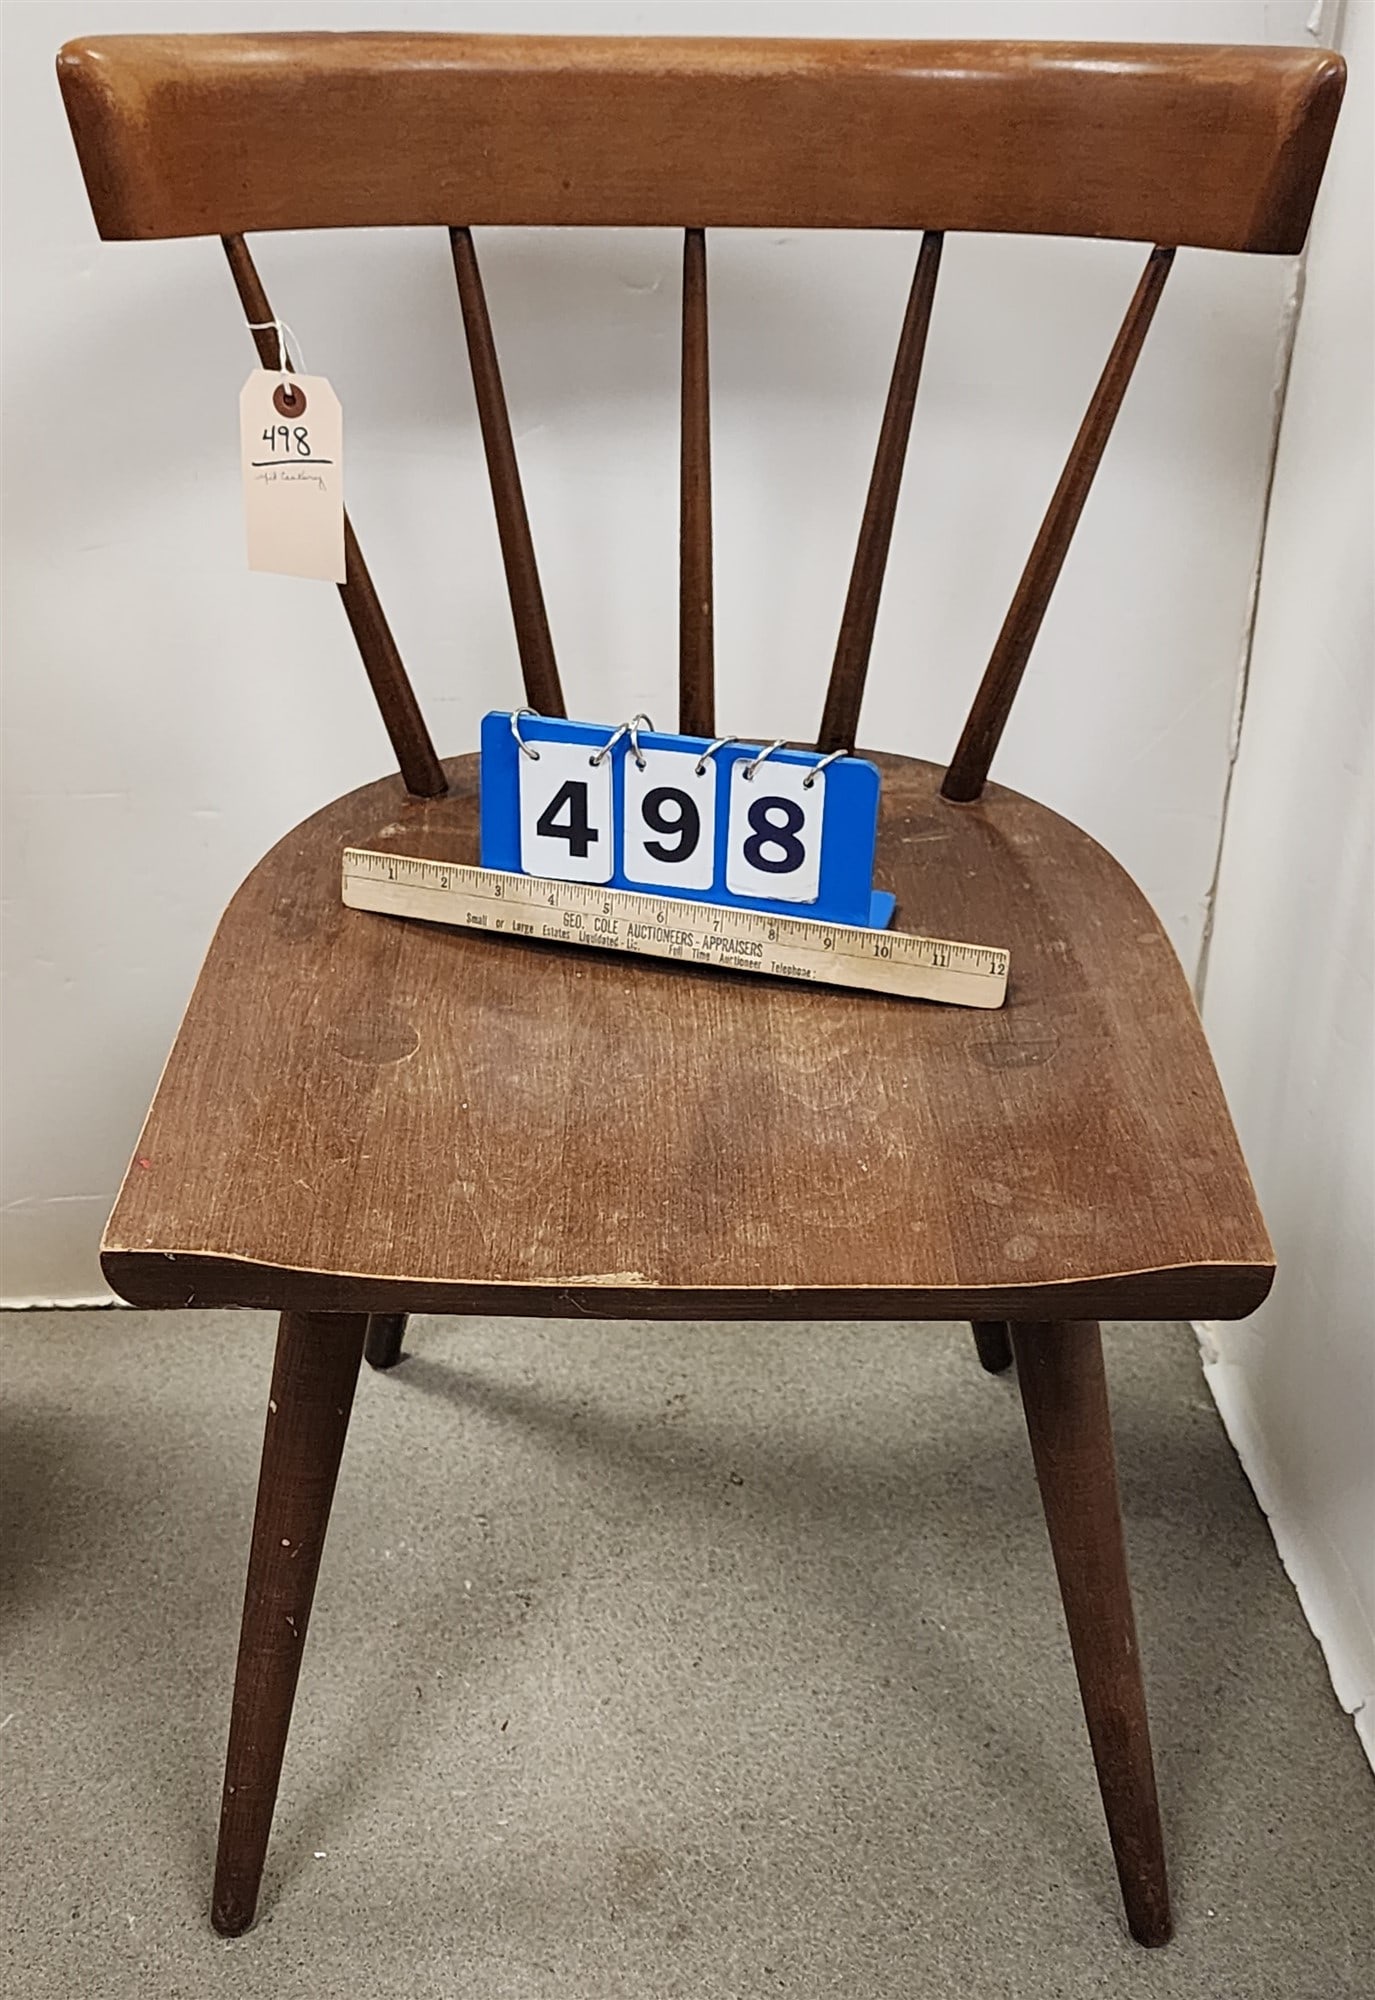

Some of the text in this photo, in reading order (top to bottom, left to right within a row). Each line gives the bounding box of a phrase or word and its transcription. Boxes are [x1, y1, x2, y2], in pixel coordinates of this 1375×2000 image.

[262, 425, 311, 456] 498
[388, 868, 1005, 976] 1 2 3 4 5 6 7 8 9 10 11 12
[466, 912, 487, 926] Small
[496, 919, 504, 928] or
[512, 920, 534, 934] Large
[542, 924, 570, 940] Estates
[563, 912, 585, 930] GEO.
[594, 917, 618, 934] COLE
